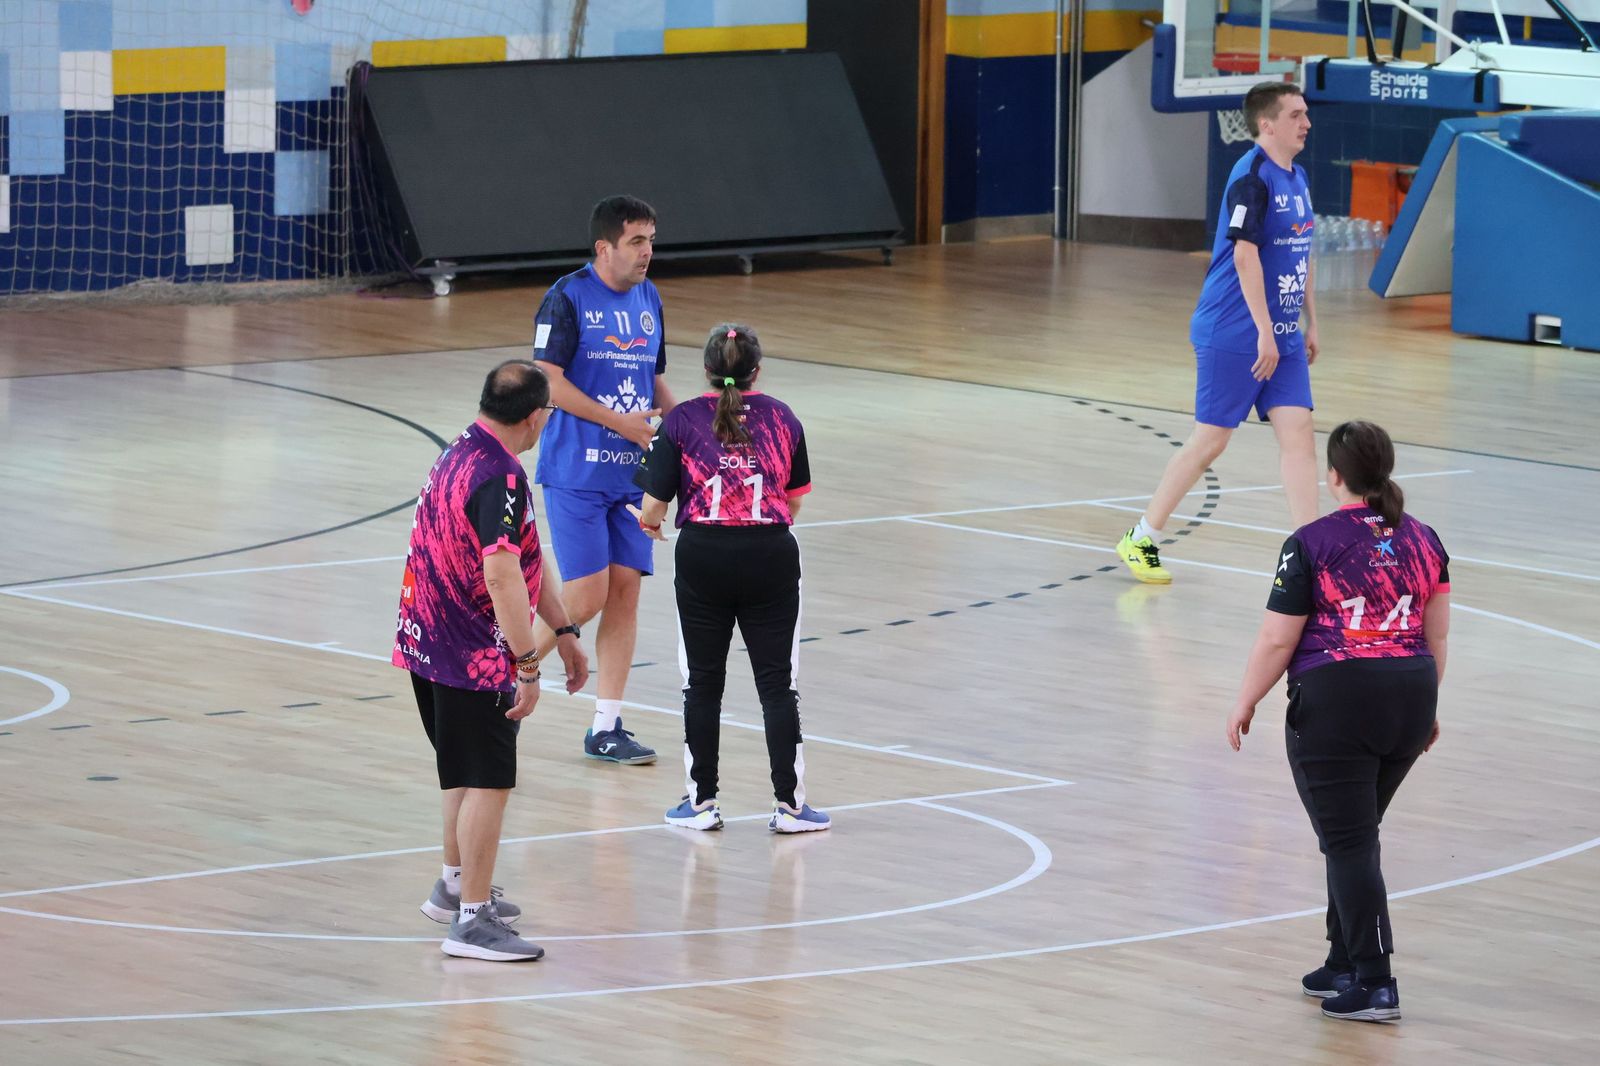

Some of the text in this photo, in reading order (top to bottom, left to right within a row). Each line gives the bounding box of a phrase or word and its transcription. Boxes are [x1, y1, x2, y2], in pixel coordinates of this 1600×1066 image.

[1370, 83, 1429, 101] Sports
[614, 311, 632, 335] 11
[600, 449, 640, 465] OVIEDO
[719, 455, 756, 469] SOLE
[697, 473, 773, 523] 11
[1340, 594, 1413, 631] 14
